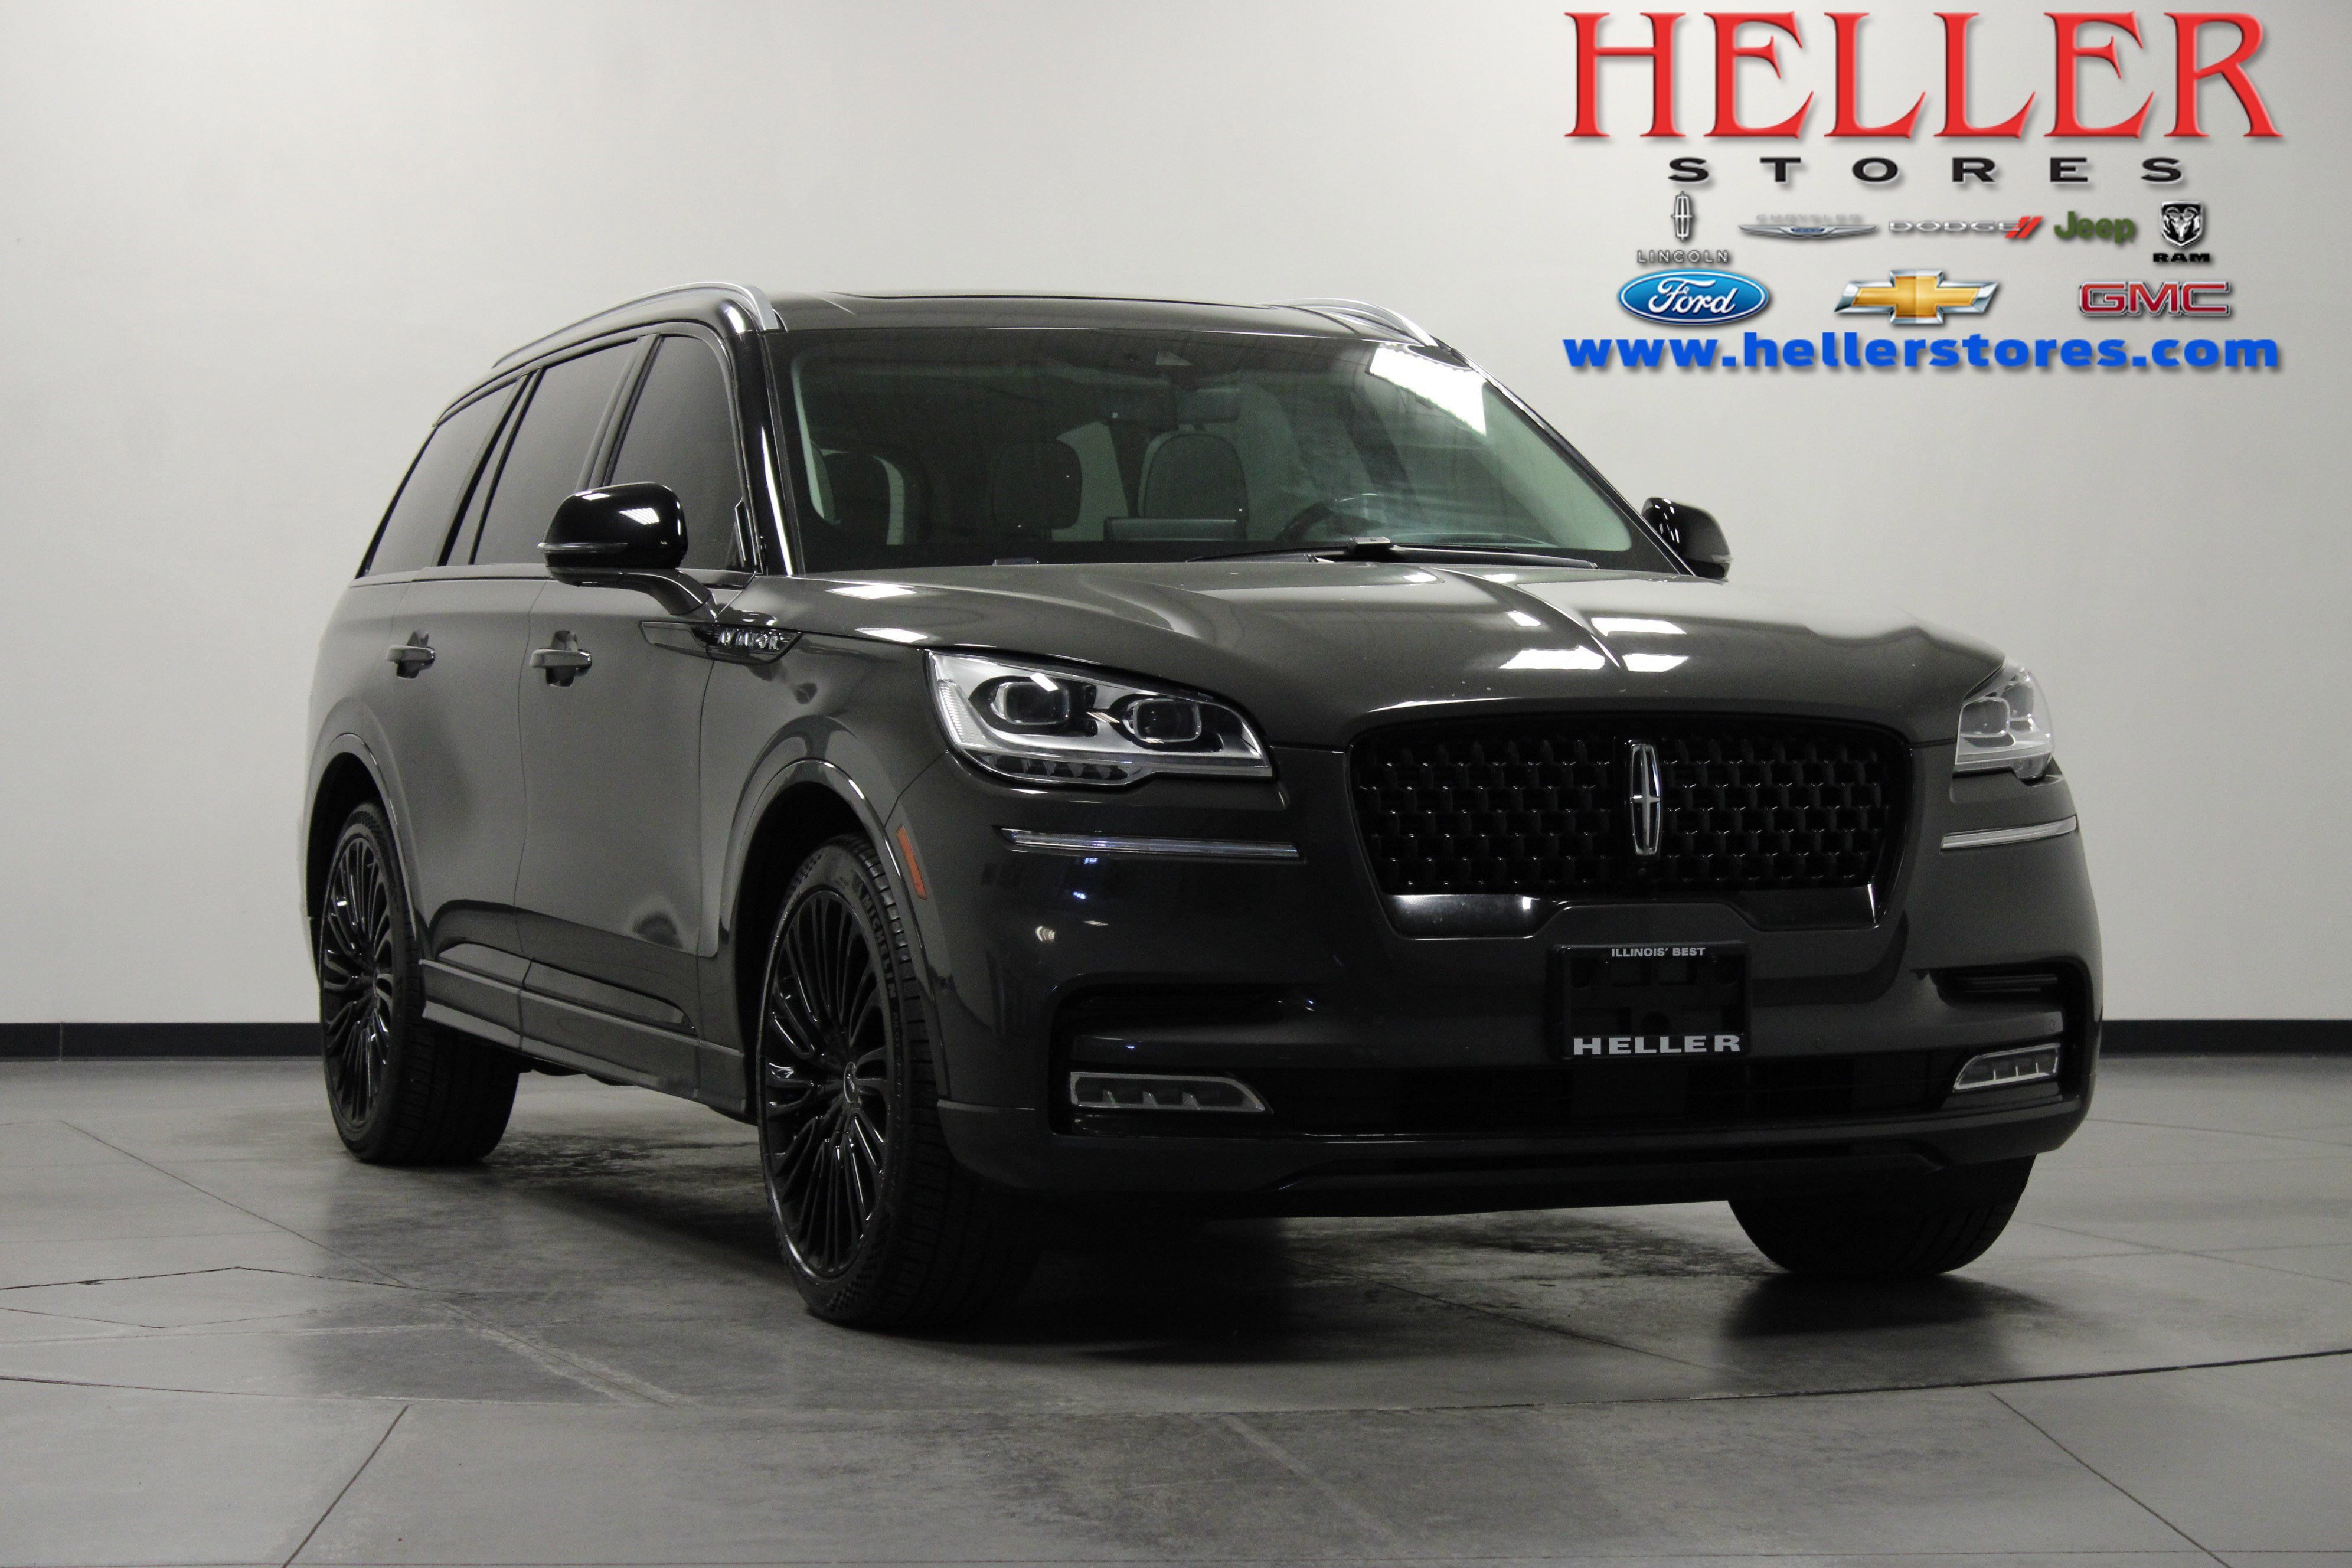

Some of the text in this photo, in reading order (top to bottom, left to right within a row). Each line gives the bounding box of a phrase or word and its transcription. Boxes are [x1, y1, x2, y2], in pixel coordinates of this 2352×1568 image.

[862, 893, 897, 998] MICHELIN
[1611, 947, 1706, 958] ILLINOIS' BEST
[1573, 1035, 1740, 1055] HELLER
